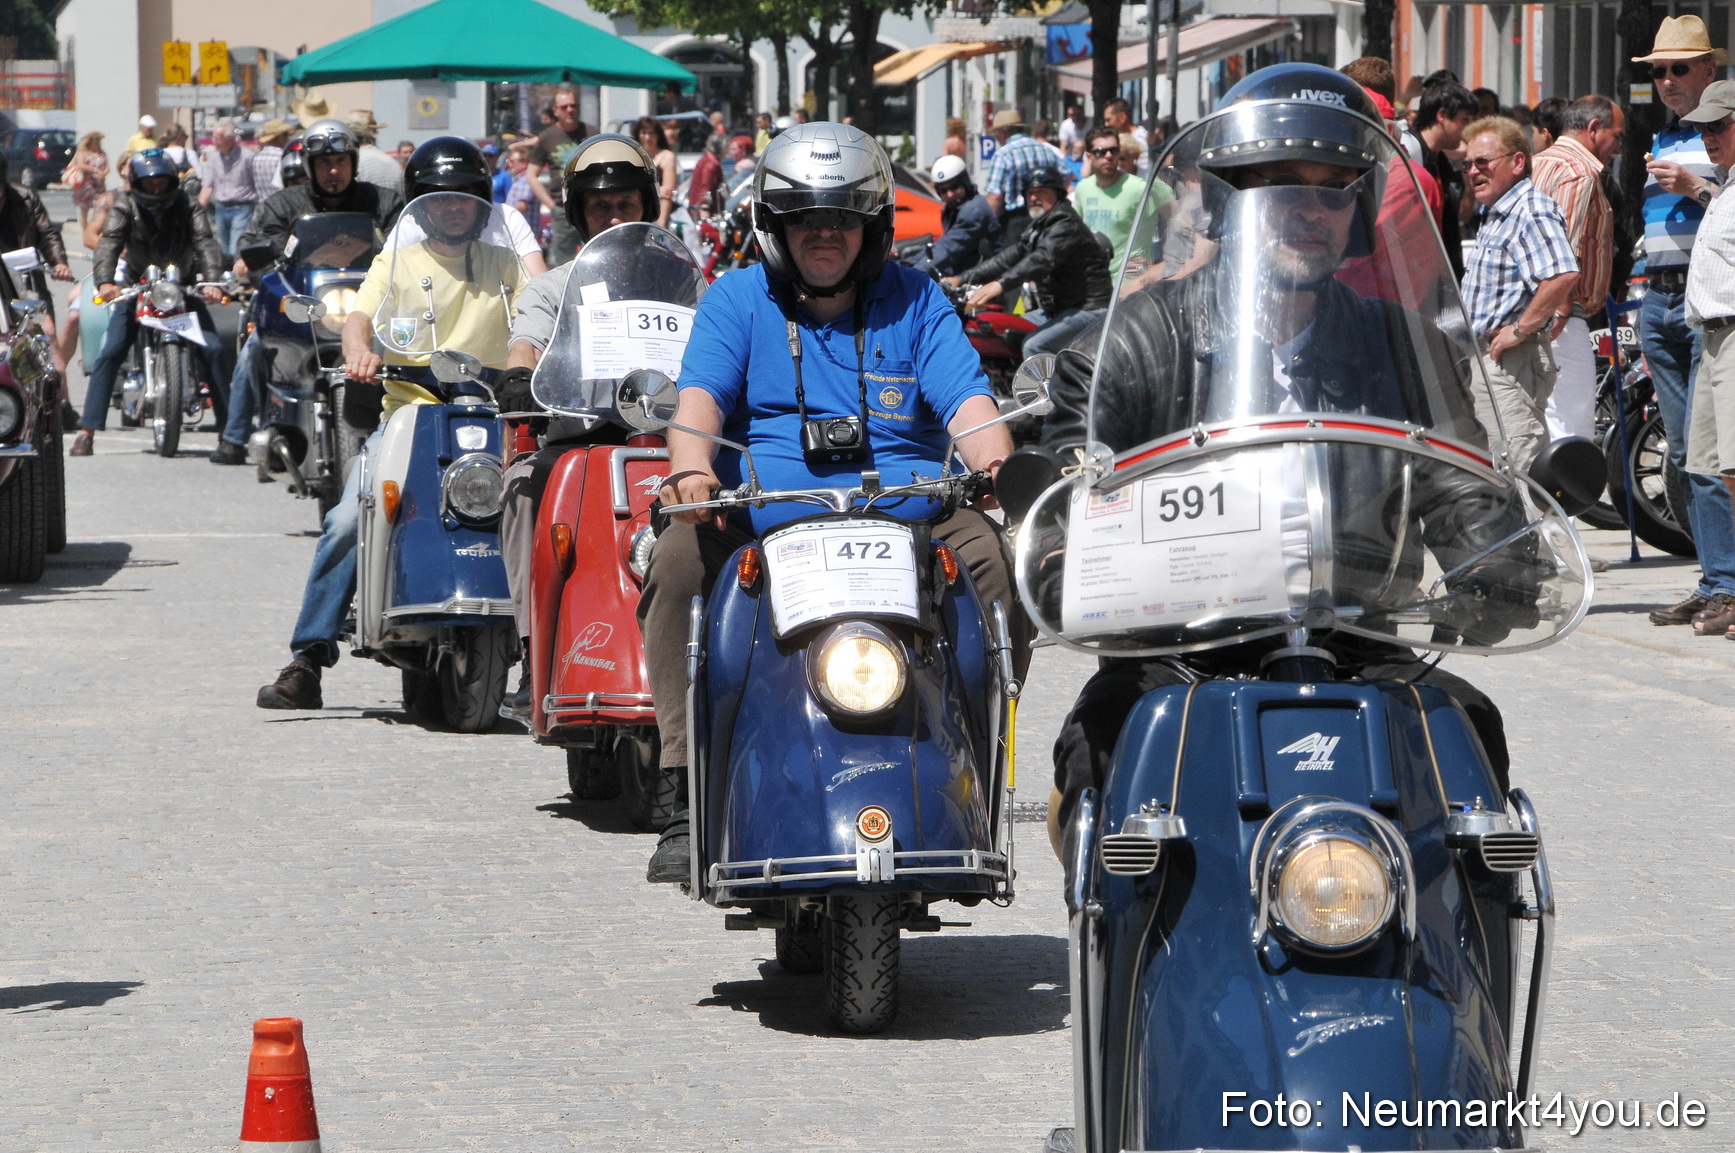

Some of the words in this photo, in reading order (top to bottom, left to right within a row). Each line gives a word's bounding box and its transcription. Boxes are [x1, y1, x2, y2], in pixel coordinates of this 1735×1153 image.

[982, 139, 995, 157] P
[805, 173, 845, 181] Scuberth
[637, 313, 678, 333] 316
[864, 371, 885, 382] Freunde
[1159, 481, 1224, 522] 591
[837, 541, 892, 560] 472
[573, 652, 616, 671] HANNIBAL
[1294, 760, 1335, 771] HEINKEL
